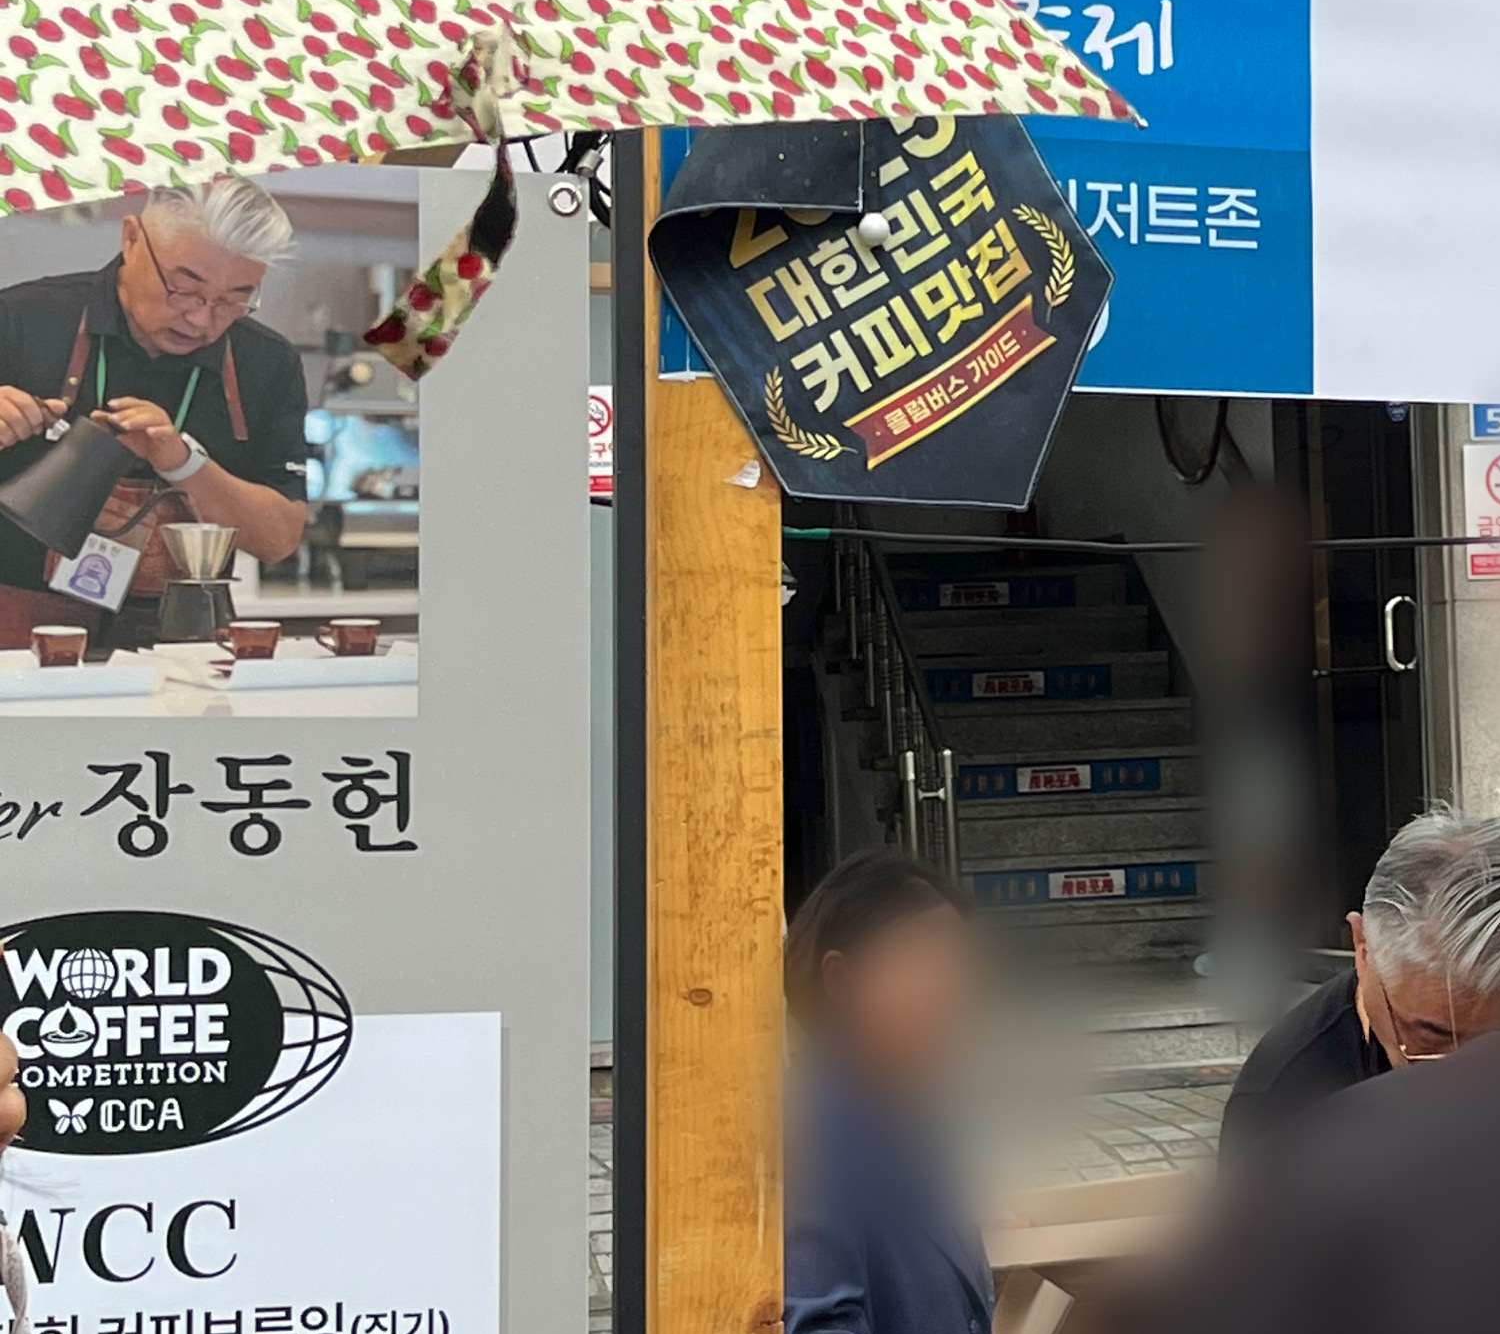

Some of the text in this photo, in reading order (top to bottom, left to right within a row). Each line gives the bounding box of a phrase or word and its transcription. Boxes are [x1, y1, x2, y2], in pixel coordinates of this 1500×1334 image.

[746, 150, 996, 343] 대한민국
[790, 217, 1033, 413] 커피맛집
[965, 330, 1021, 383] 가이드
[80, 750, 418, 858] 장동헌
[4, 947, 232, 1001] WORLD
[3, 1001, 230, 1059] COFFEE
[14, 1061, 228, 1088] OMPETITION
[100, 1098, 184, 1133] CCA
